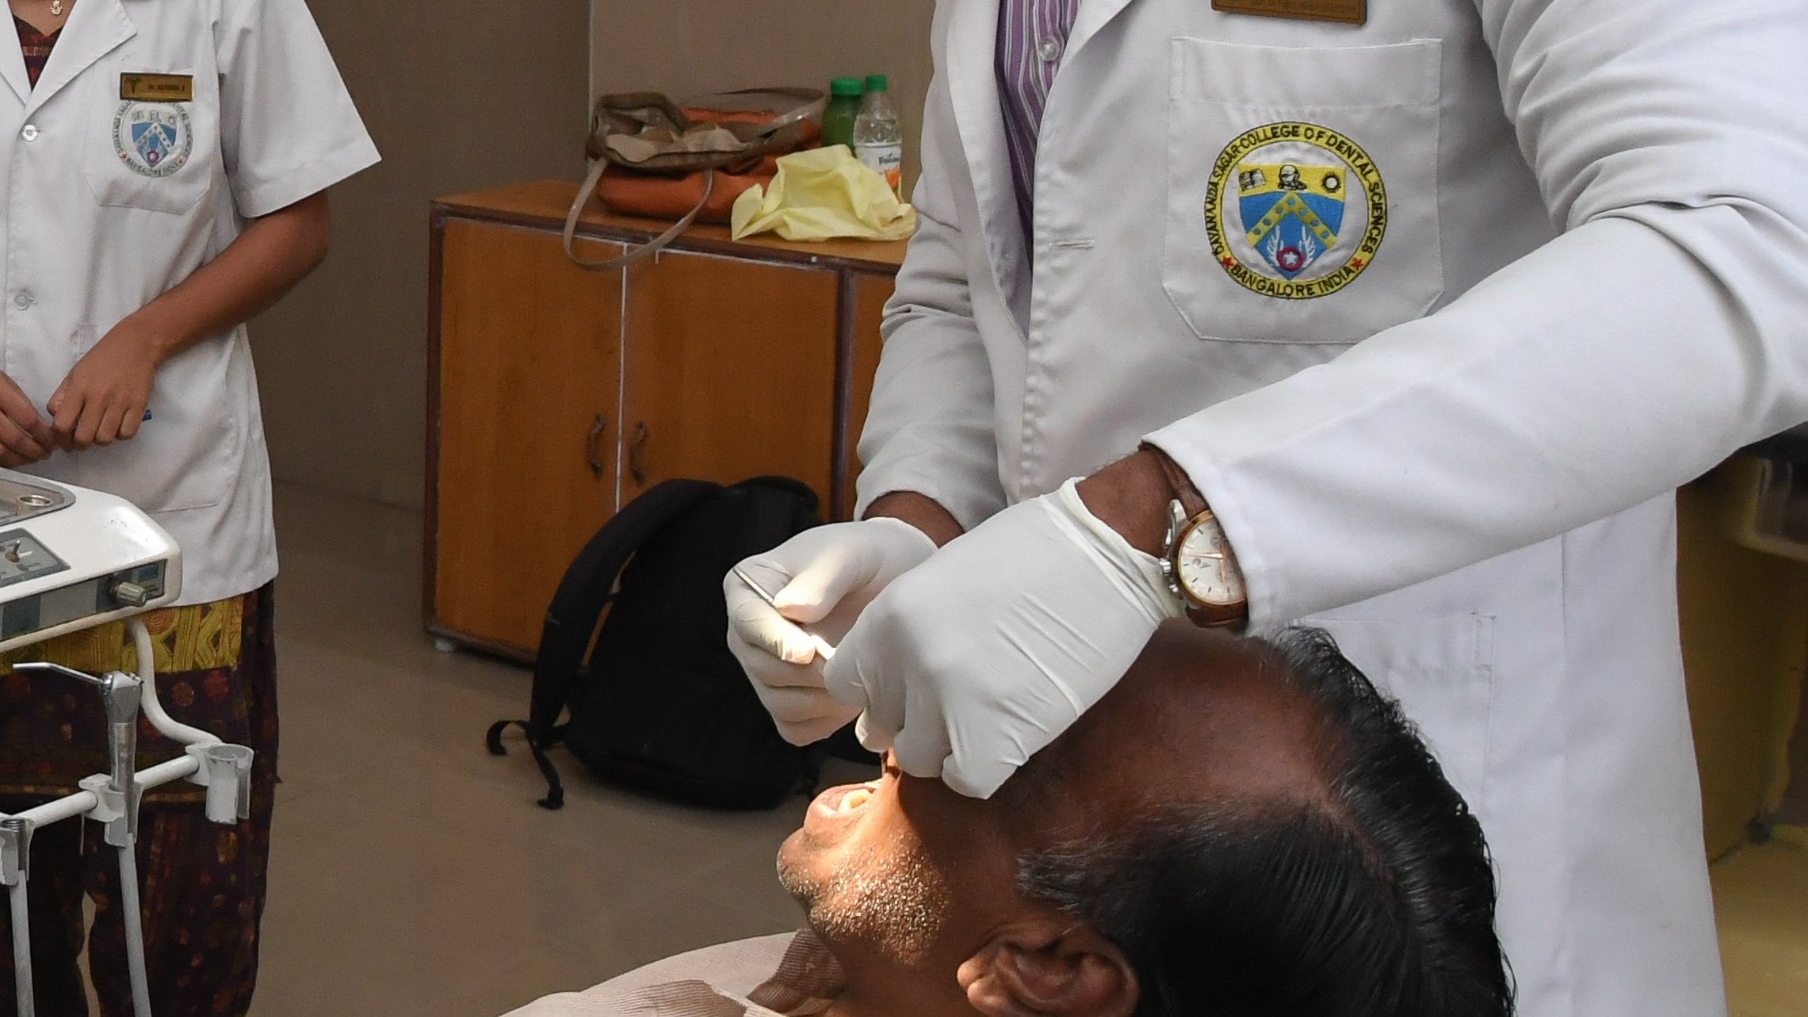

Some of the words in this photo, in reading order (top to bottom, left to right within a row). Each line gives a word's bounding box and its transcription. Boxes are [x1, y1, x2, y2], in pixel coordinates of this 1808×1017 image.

[1213, 143, 1241, 182] SAGAR
[1240, 125, 1301, 150] COLLEGE
[1304, 126, 1326, 142] OF
[1325, 133, 1375, 181] DENTAL
[1361, 181, 1383, 255] SCIENCES
[1231, 263, 1316, 297] BANGALORE
[1318, 267, 1356, 294] INDIA
